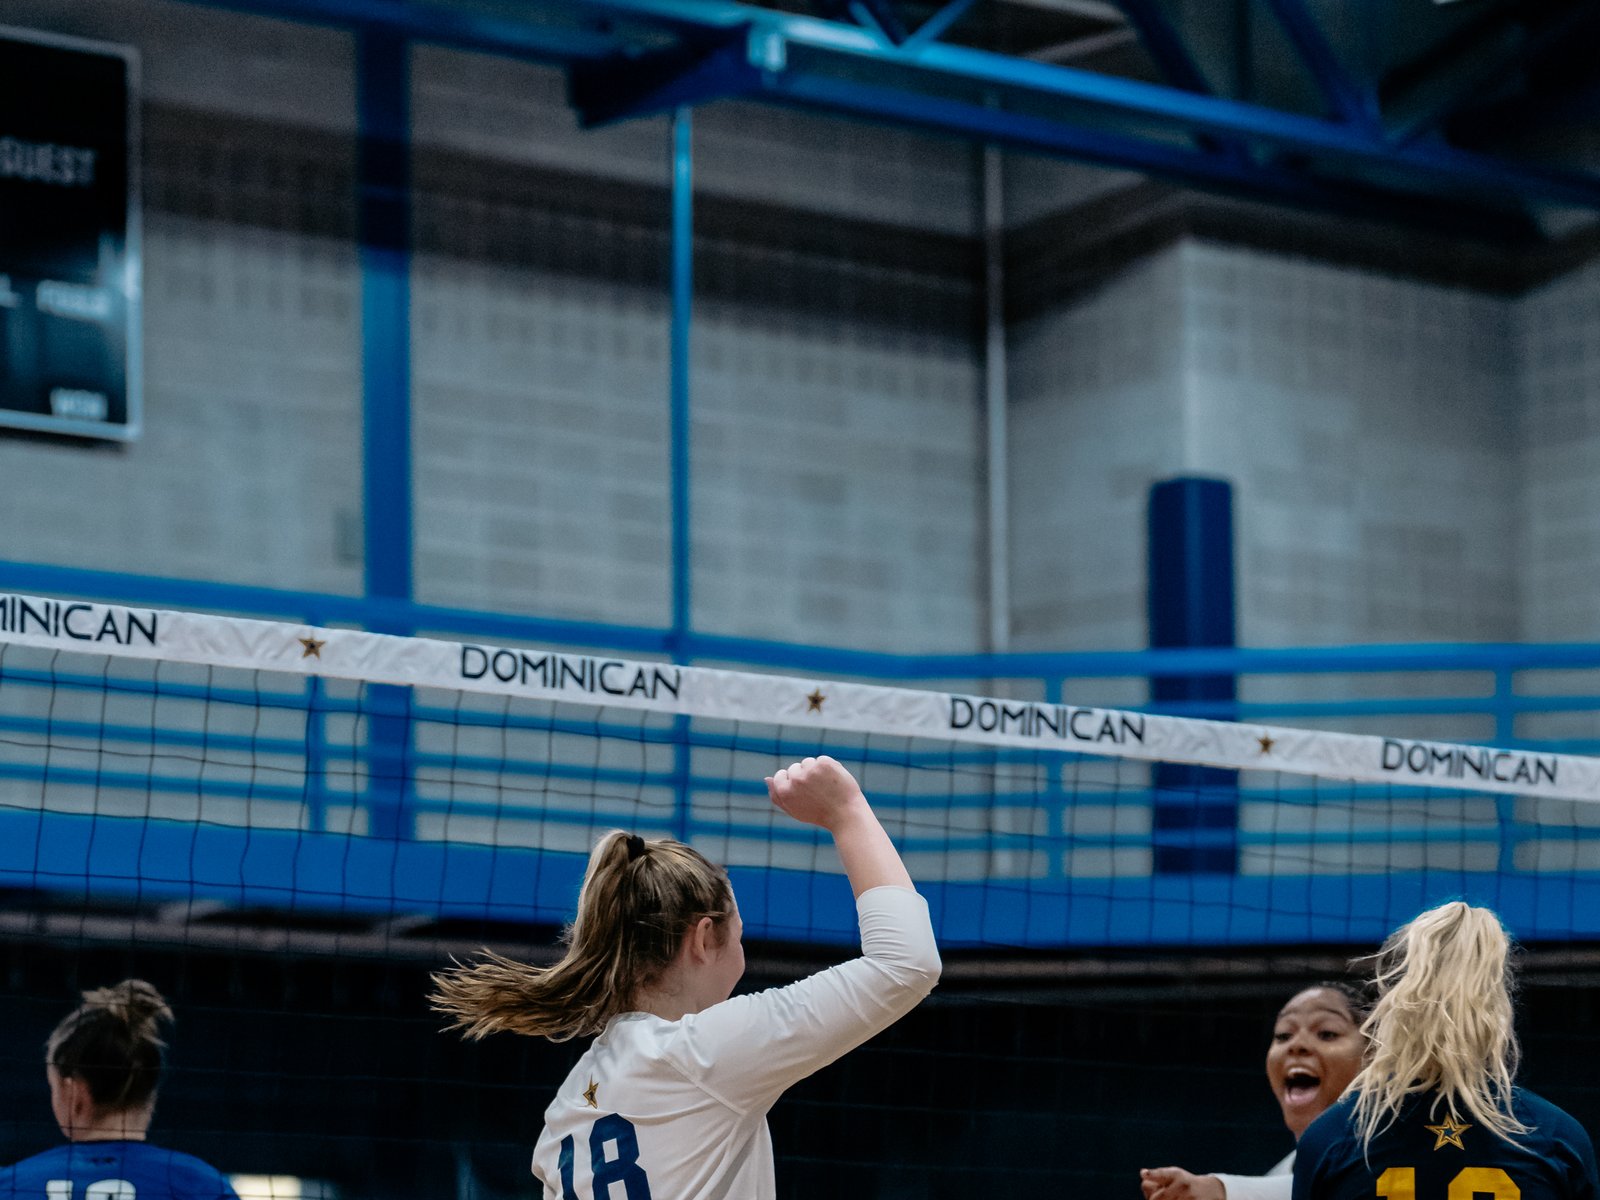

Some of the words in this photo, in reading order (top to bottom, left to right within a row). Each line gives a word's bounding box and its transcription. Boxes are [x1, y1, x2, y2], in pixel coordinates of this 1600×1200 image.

[0, 597, 157, 645] INICAN
[461, 646, 680, 700] DOMINICAN
[950, 698, 1145, 744] DOMINICAN
[1382, 738, 1558, 784] DOMINICAN
